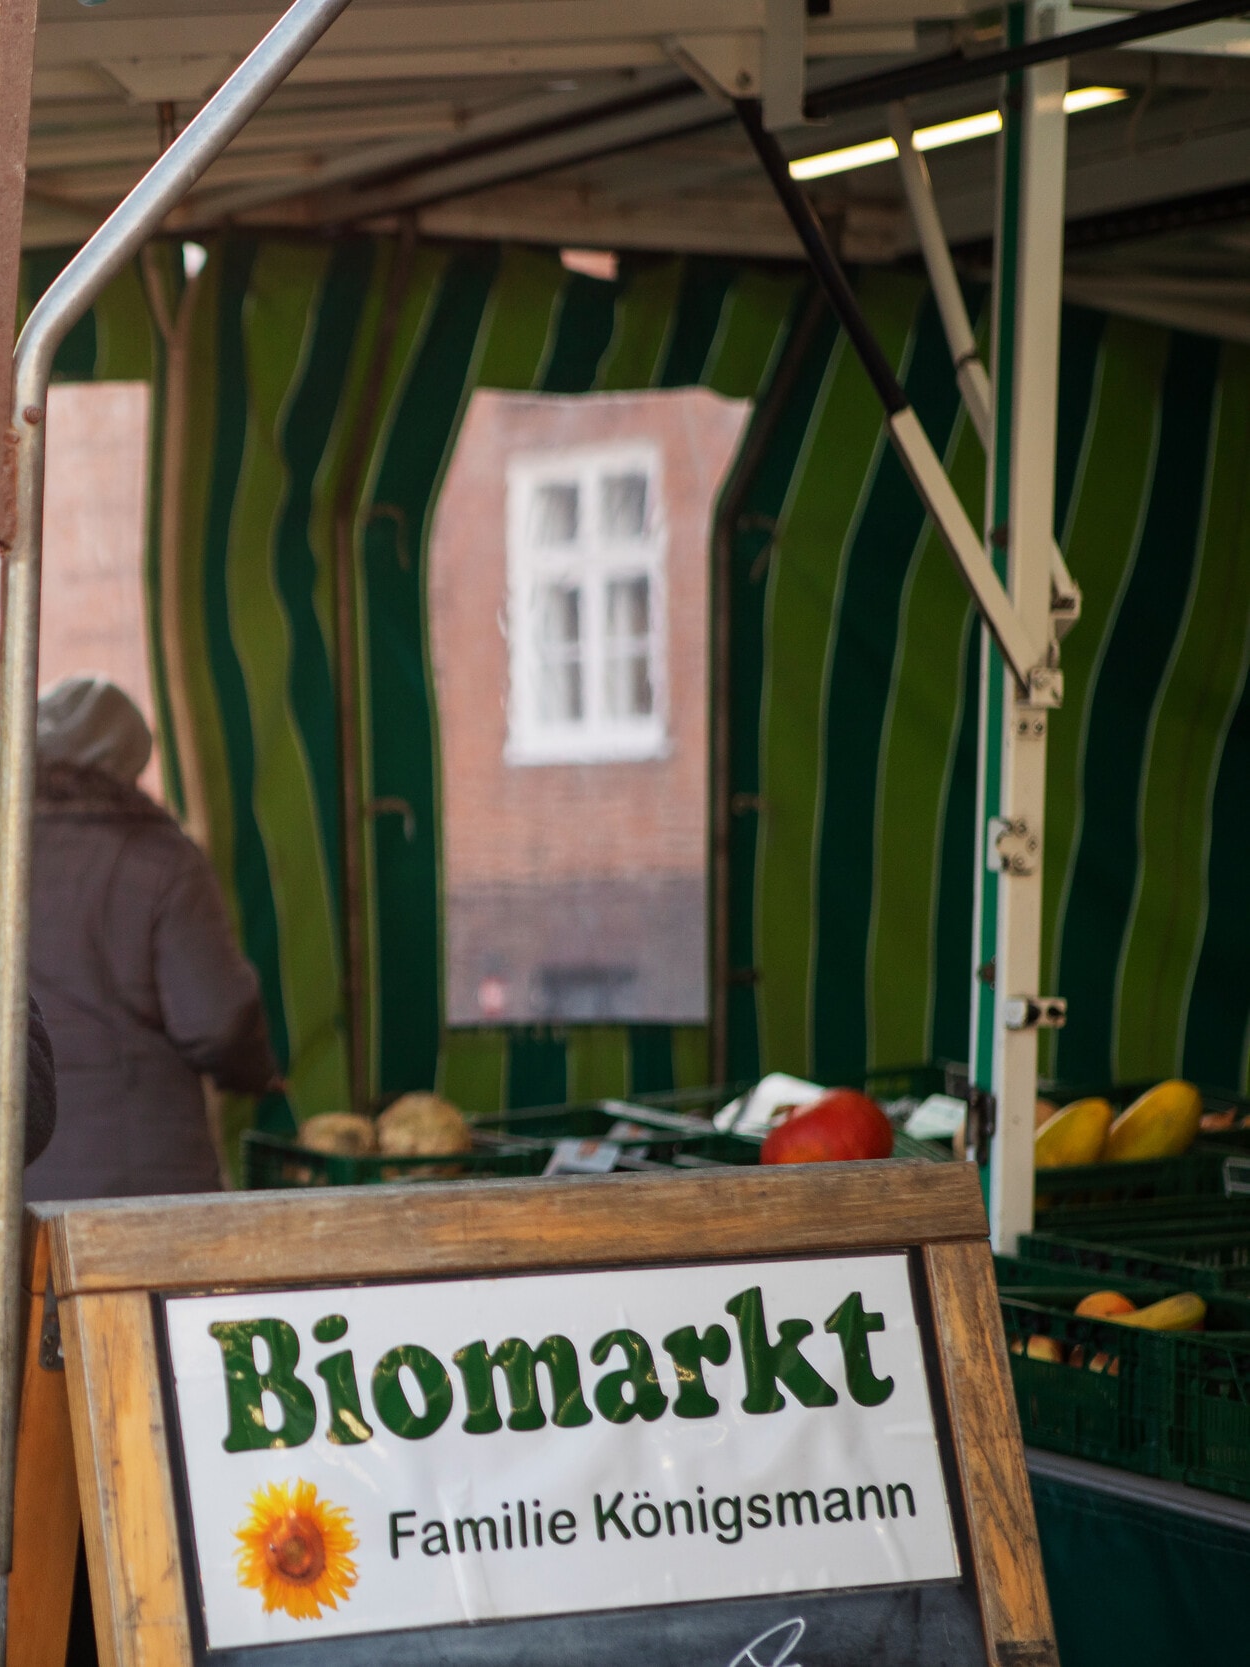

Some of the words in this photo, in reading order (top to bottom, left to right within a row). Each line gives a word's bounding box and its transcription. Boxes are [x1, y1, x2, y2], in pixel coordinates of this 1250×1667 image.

[208, 1286, 895, 1454] Biomarkt
[389, 1499, 577, 1559] Familie
[593, 1482, 917, 1545] Königsmann
